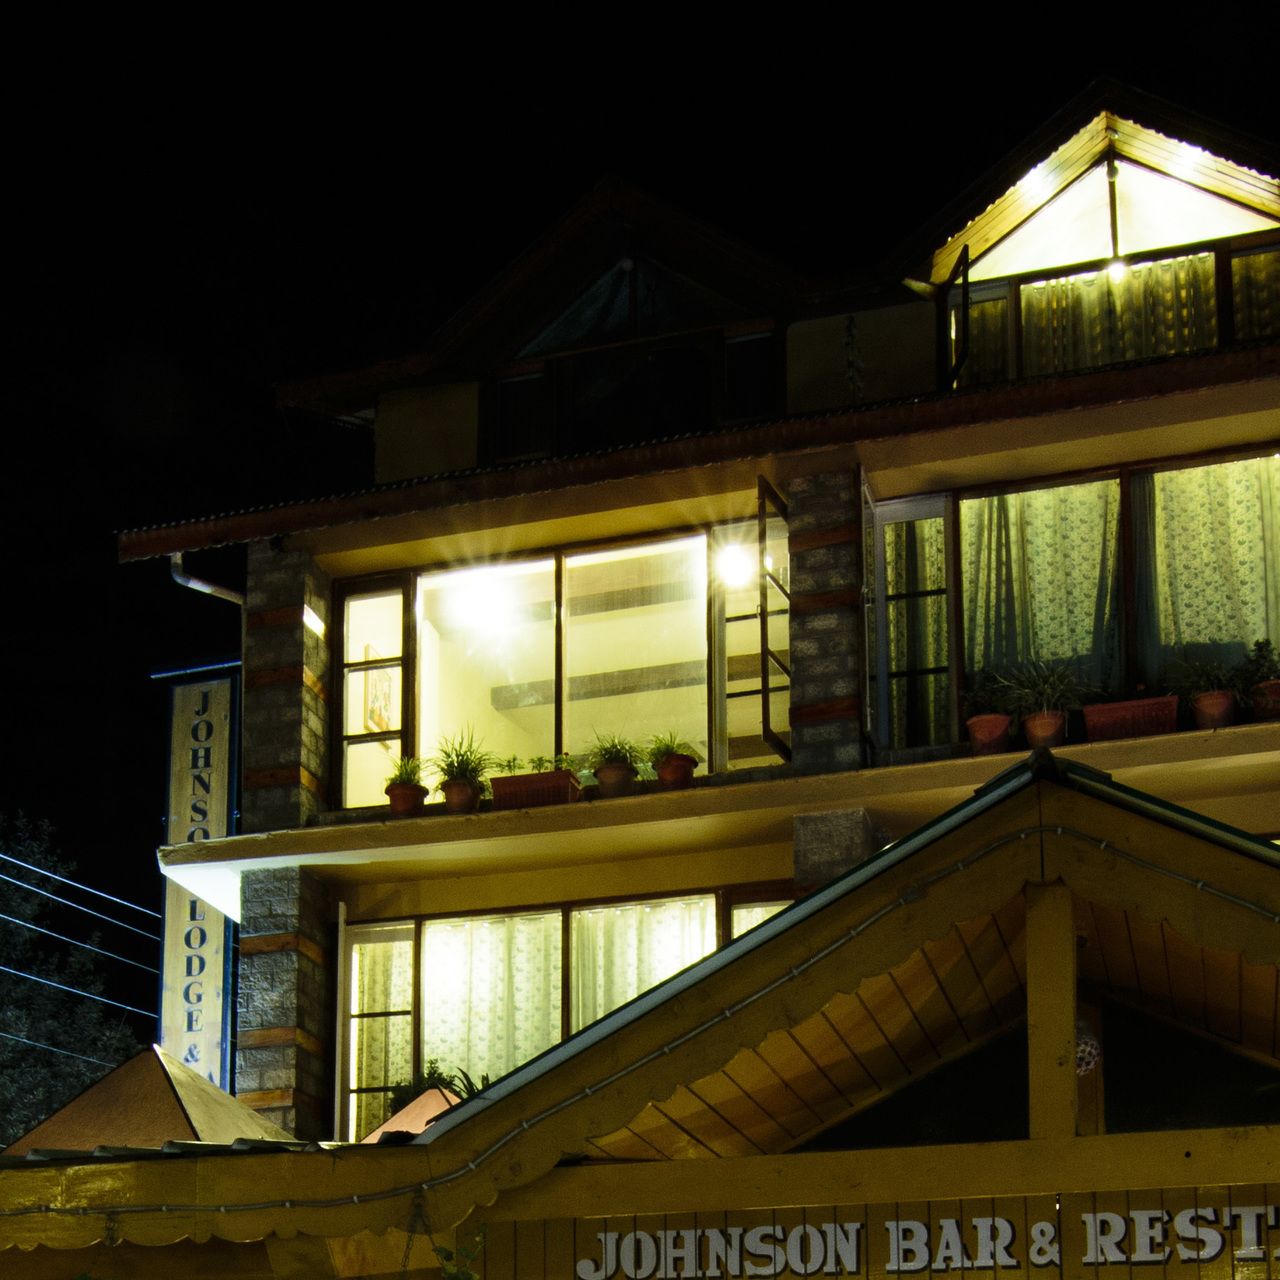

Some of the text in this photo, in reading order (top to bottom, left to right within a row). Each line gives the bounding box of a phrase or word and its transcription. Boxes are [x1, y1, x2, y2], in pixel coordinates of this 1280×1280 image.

[182, 689, 215, 1064] JOHNSO LODGE &
[885, 1217, 1019, 1273] BAR
[1029, 1221, 1061, 1267] &
